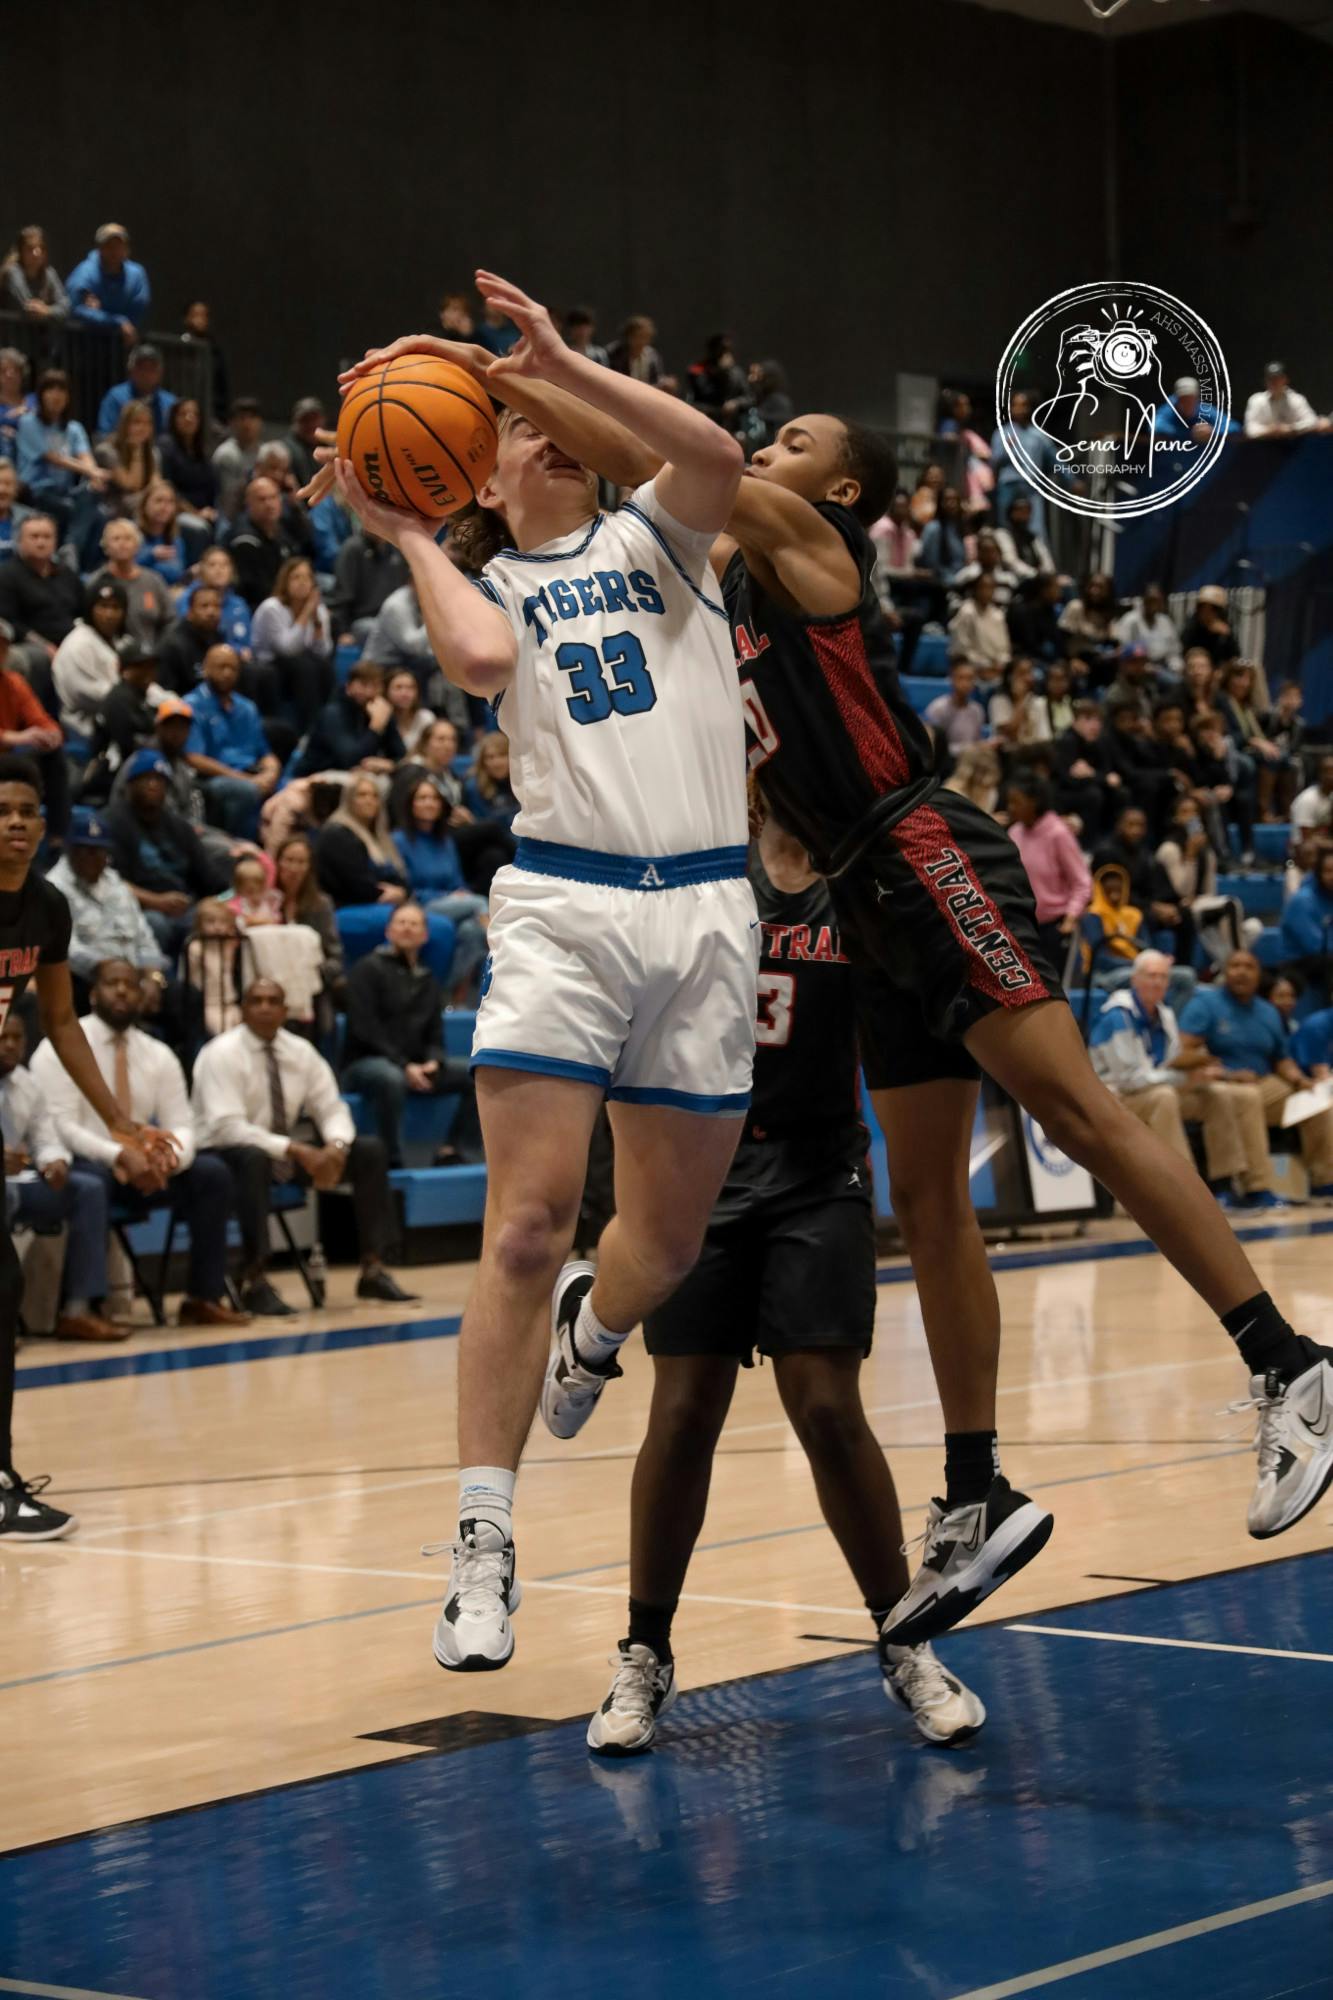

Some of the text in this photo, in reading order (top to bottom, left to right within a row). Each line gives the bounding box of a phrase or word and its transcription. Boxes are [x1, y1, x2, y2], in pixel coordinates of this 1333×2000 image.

[522, 568, 666, 649] TIGERS
[555, 630, 658, 726] 33
[760, 921, 850, 964] TRAL
[923, 847, 1032, 991] CENTRAL
